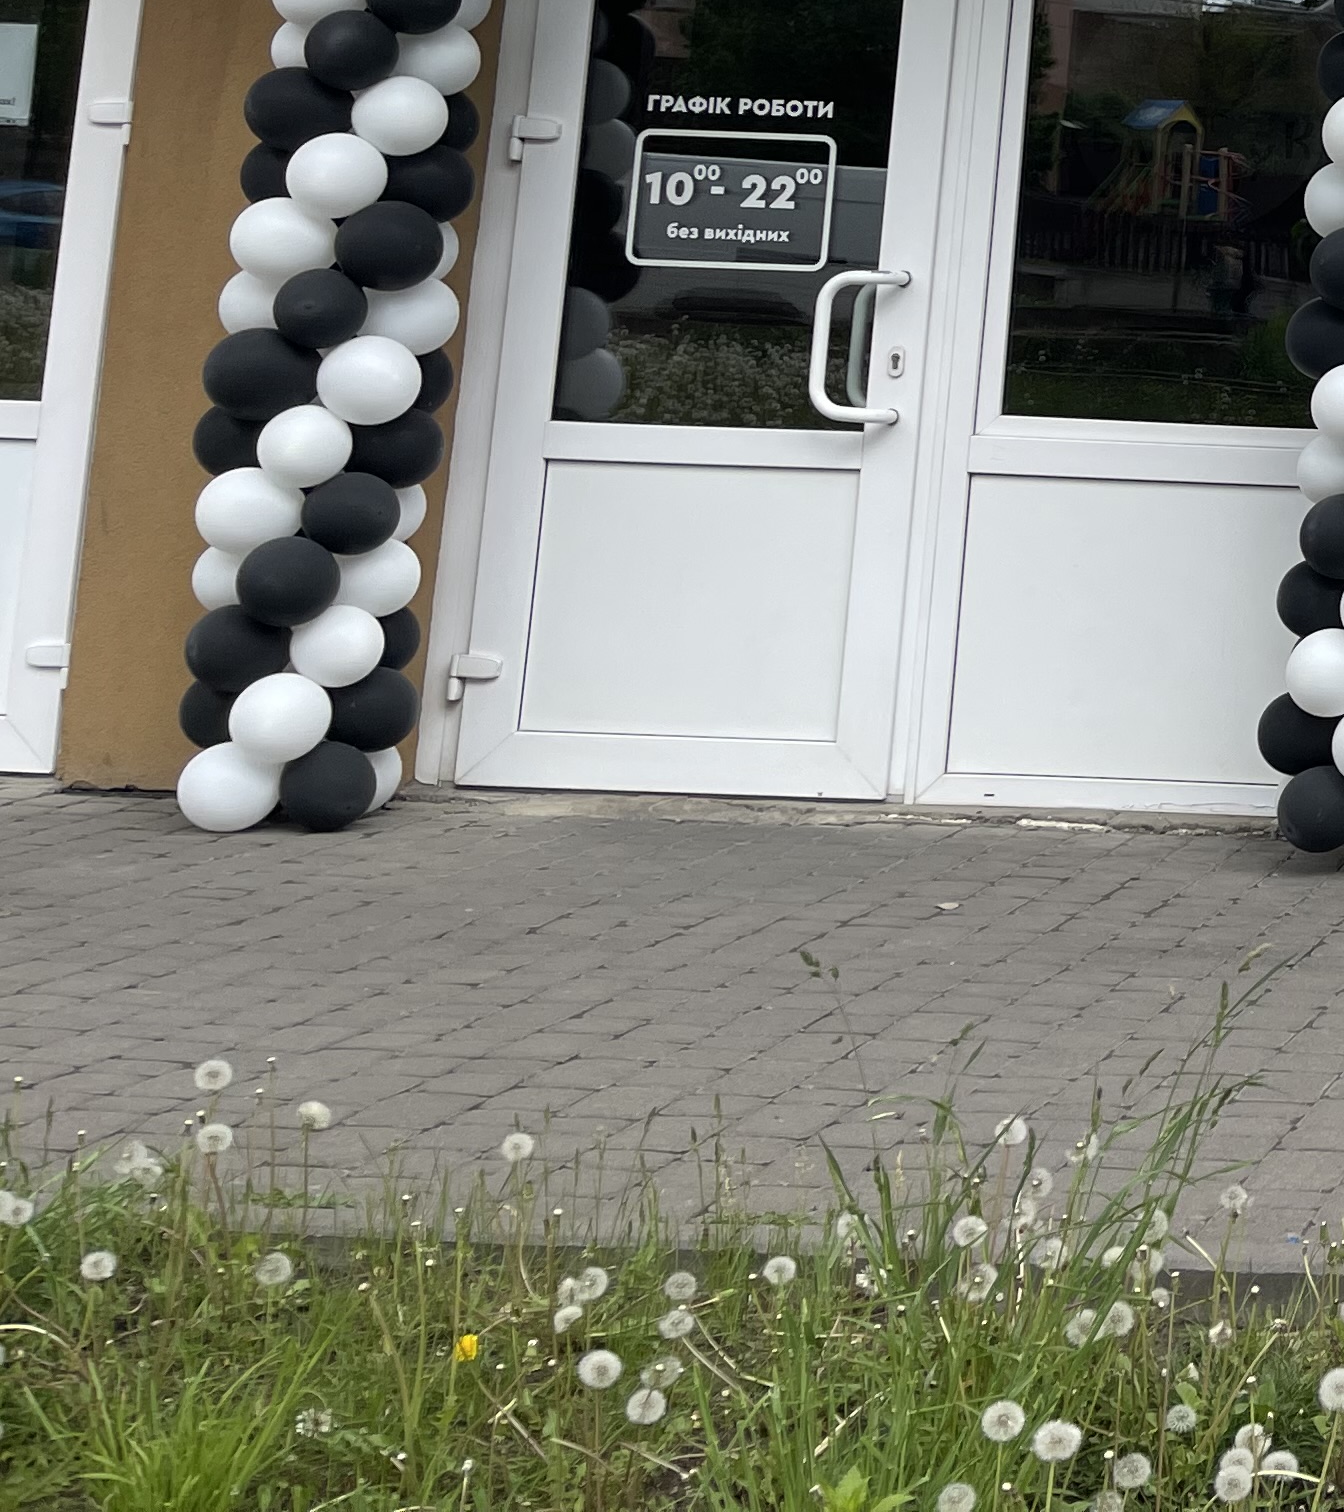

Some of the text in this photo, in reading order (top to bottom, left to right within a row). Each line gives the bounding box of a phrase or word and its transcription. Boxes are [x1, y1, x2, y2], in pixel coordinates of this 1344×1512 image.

[646, 94, 834, 118] ГРАФІК РОБОТИ
[666, 222, 790, 243] без вихідних
